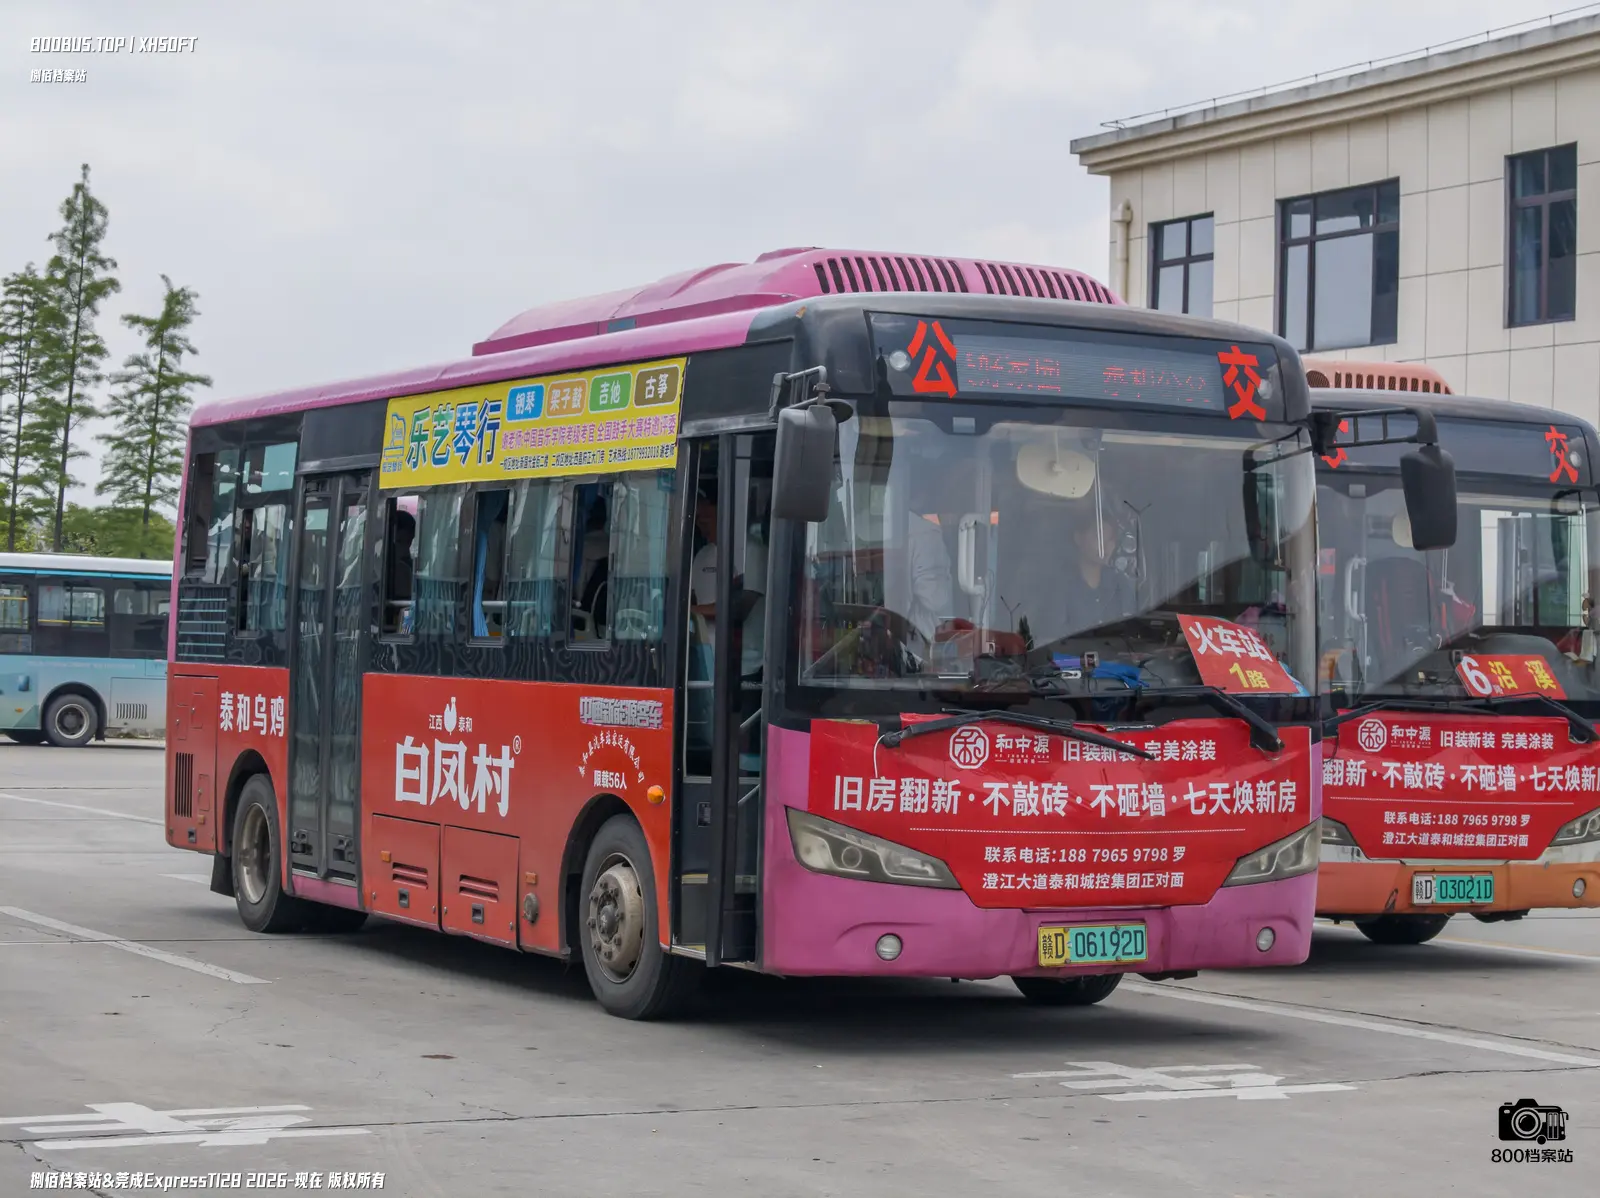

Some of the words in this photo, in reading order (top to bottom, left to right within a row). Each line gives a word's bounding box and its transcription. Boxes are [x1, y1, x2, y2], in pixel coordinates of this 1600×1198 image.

[906, 320, 958, 399] 公
[1217, 345, 1267, 421] 交
[599, 381, 621, 404] 吉他
[645, 373, 669, 399] 古筝
[515, 391, 537, 415] 钢琴
[550, 387, 584, 411] 架子鼓
[405, 398, 503, 469] 乐艺琴行
[596, 413, 677, 443] 全国鼓手大赛特邀评委
[1544, 425, 1579, 484] 交
[1188, 621, 1273, 663] 火车站
[1229, 662, 1270, 689] 1路
[220, 691, 285, 737] 泰和乌鸡
[429, 714, 442, 730] 江西
[458, 716, 473, 733] 泰和
[995, 733, 1050, 754] 和中源
[1062, 739, 1136, 763] 旧装新装
[1144, 739, 1217, 763] 完美涂装
[1391, 725, 1431, 741] 和中源
[1440, 731, 1496, 748] 旧装新装
[1501, 732, 1554, 750] 完美涂装
[395, 735, 515, 818] 白凤村
[593, 770, 627, 790] 限载56人
[1384, 812, 1459, 826] 联系电话:188
[1462, 814, 1488, 826] 7965
[1492, 814, 1517, 827] 9798
[1520, 814, 1531, 827] 罗
[1382, 832, 1529, 847] 澄江大道泰和城控集团正对面
[984, 845, 1087, 865] 联系电话:188
[1093, 847, 1128, 863] 7965
[1133, 847, 1168, 863] 9798
[1172, 845, 1186, 863] 罗
[982, 872, 1186, 890] 澄江大道泰和城控集团正对面
[1416, 880, 1433, 900] 赣D
[1440, 880, 1492, 899] 03021D
[1042, 933, 1065, 959] 赣D
[1075, 930, 1144, 957] 06192D
